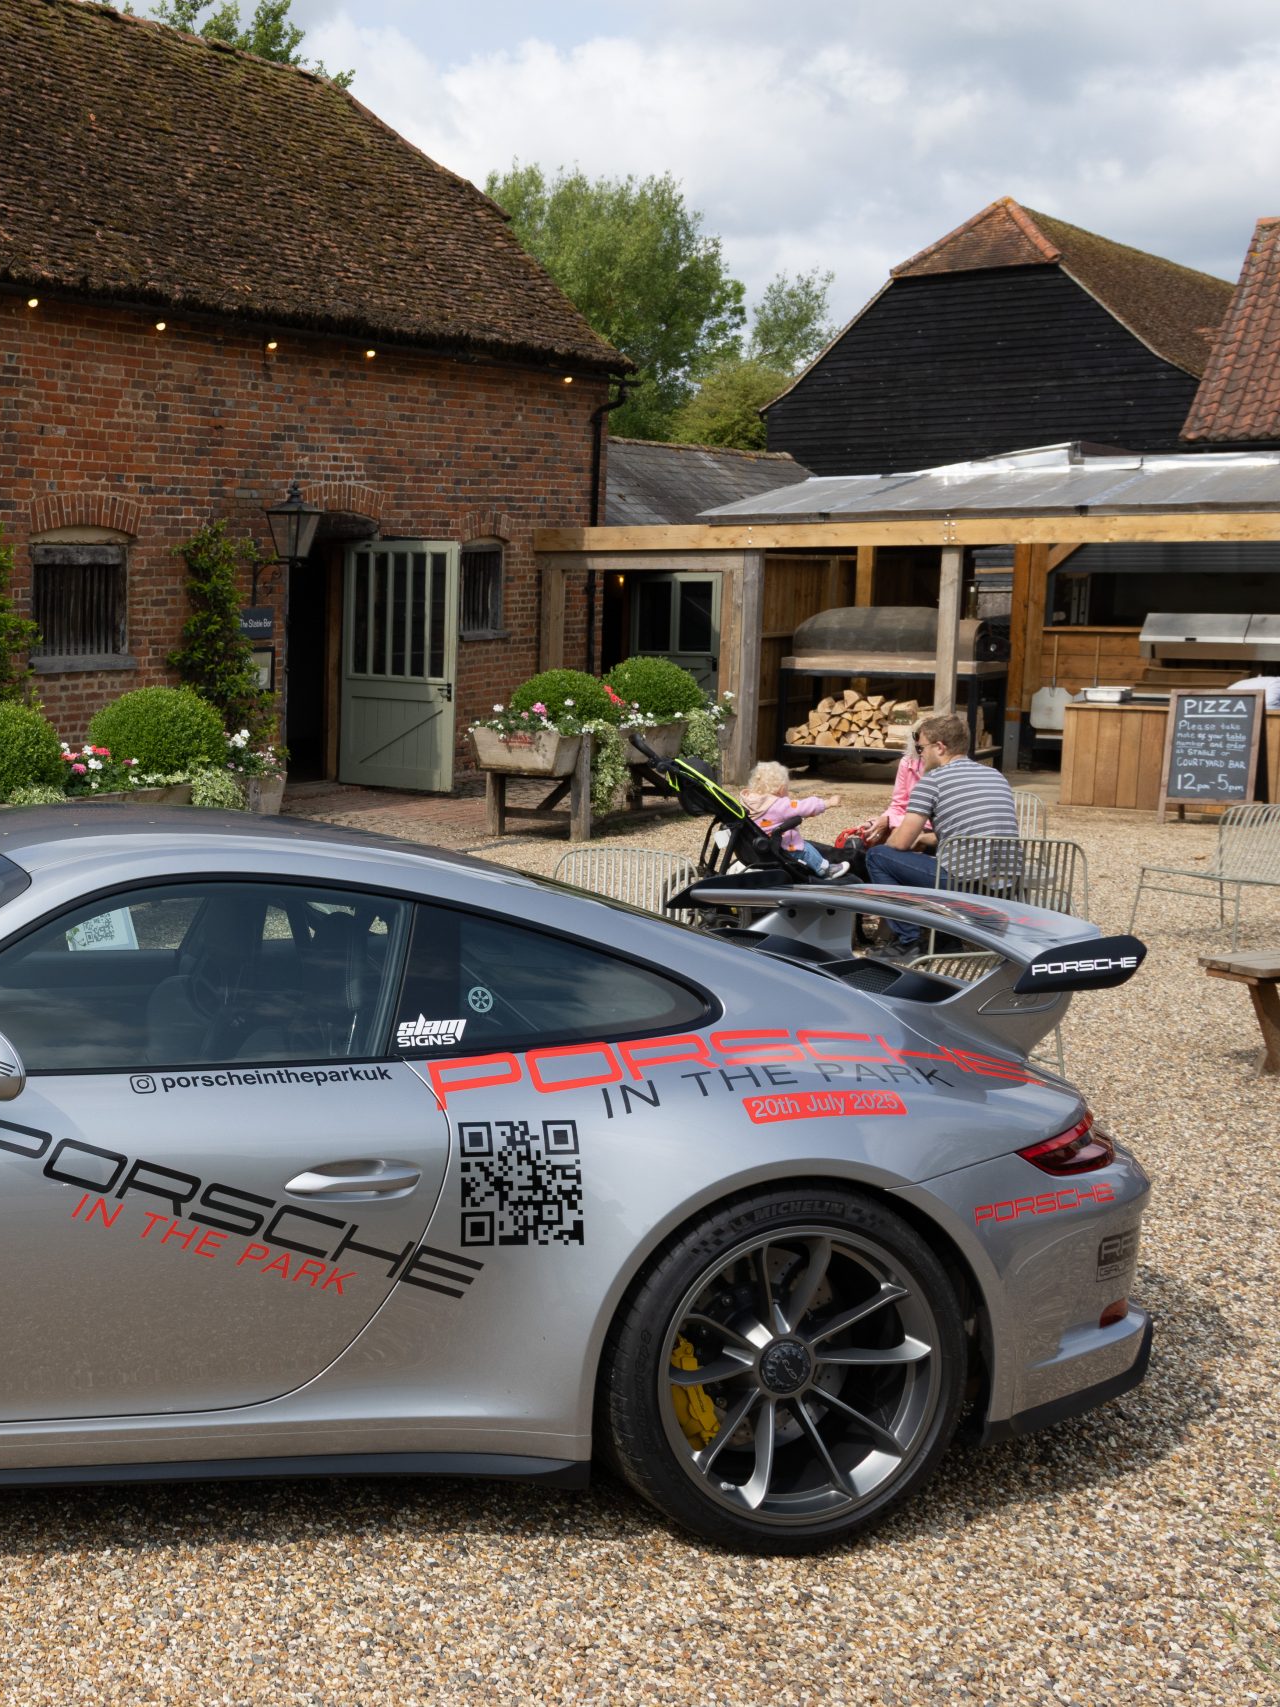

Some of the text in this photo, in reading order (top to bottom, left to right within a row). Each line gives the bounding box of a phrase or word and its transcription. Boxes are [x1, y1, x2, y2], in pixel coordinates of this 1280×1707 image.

[1184, 699, 1247, 714] PIZZA
[1178, 720, 1216, 730] Please
[1228, 760, 1247, 769] BAR
[1031, 956, 1138, 976] PORSCHE
[397, 1034, 456, 1048] SIGNS
[161, 1065, 393, 1093] porscheintheparkuk
[427, 1029, 1046, 1110] PORSCHE
[601, 1063, 955, 1119] IN THE PARK
[752, 1093, 900, 1118] 20th July 2025
[754, 1200, 846, 1223] MICHELIN
[974, 1183, 1116, 1226] PORSCHE
[71, 1193, 358, 1295] IN THE PARK
